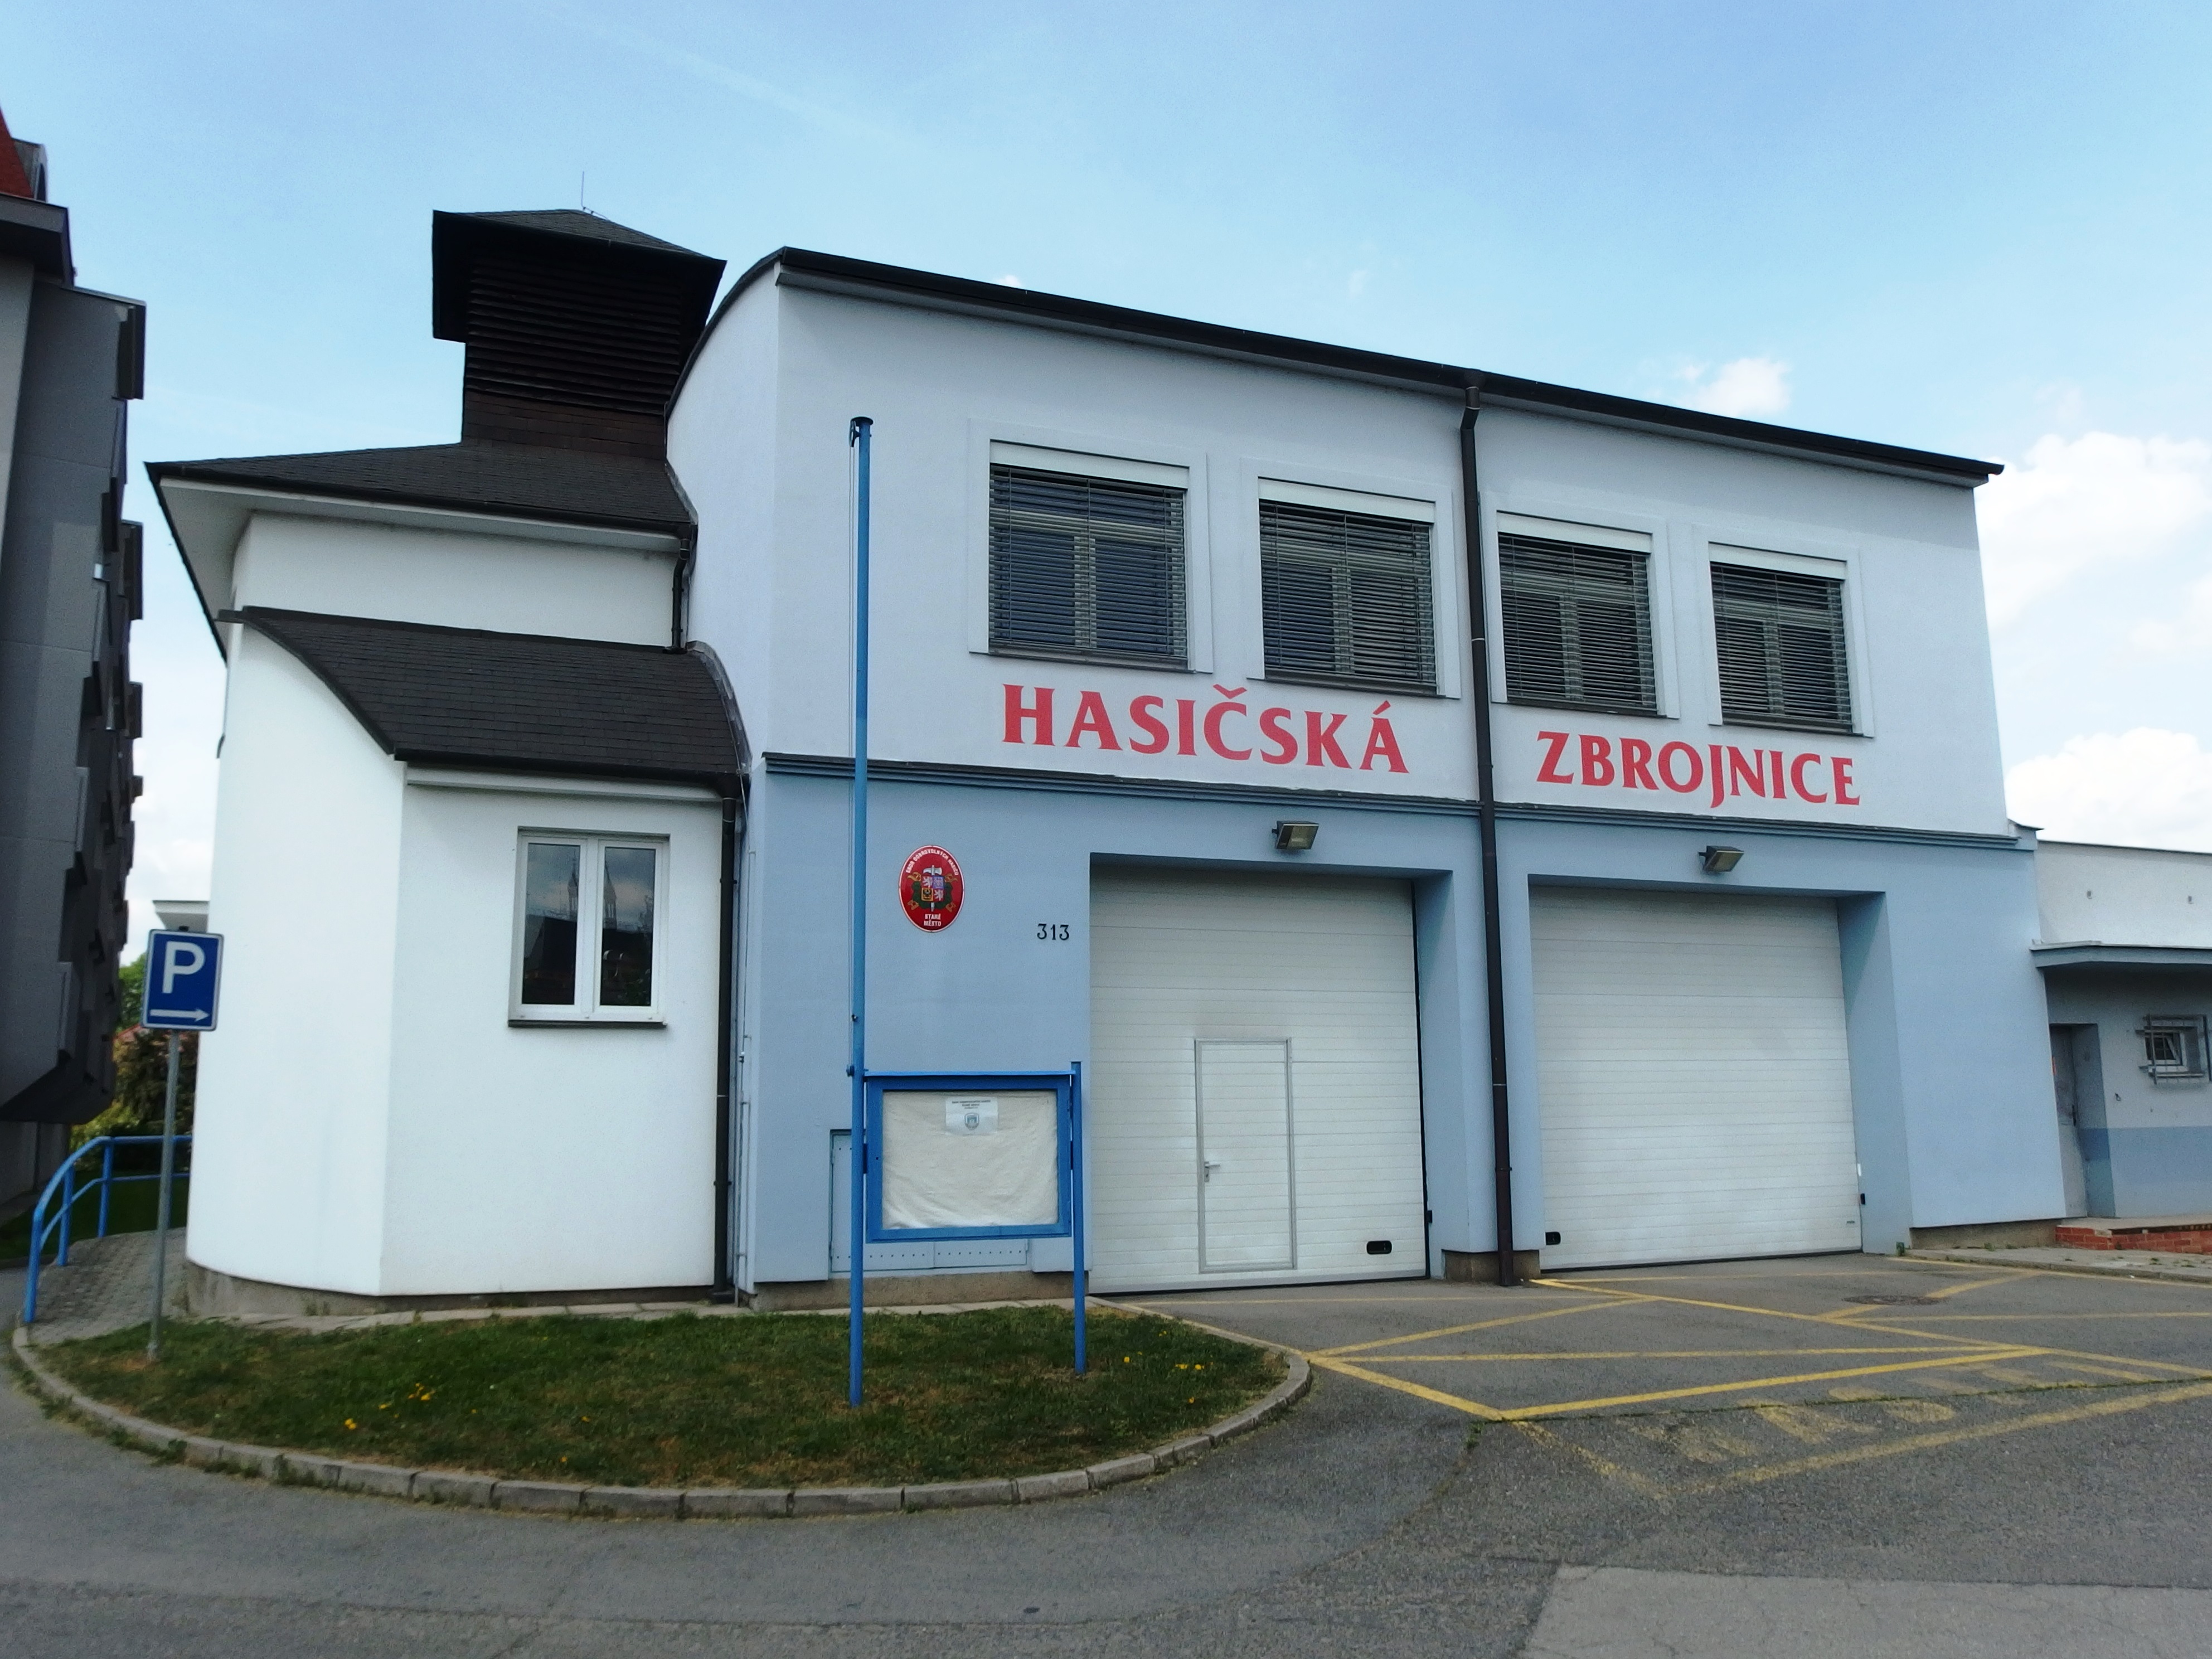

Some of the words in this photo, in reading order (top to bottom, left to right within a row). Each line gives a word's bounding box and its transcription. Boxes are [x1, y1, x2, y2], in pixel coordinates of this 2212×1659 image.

[1003, 684, 1409, 773] HASIČSKÁ
[1536, 731, 1860, 808] ZBROJNICE
[1037, 923, 1069, 940] 313
[162, 941, 206, 993] P
